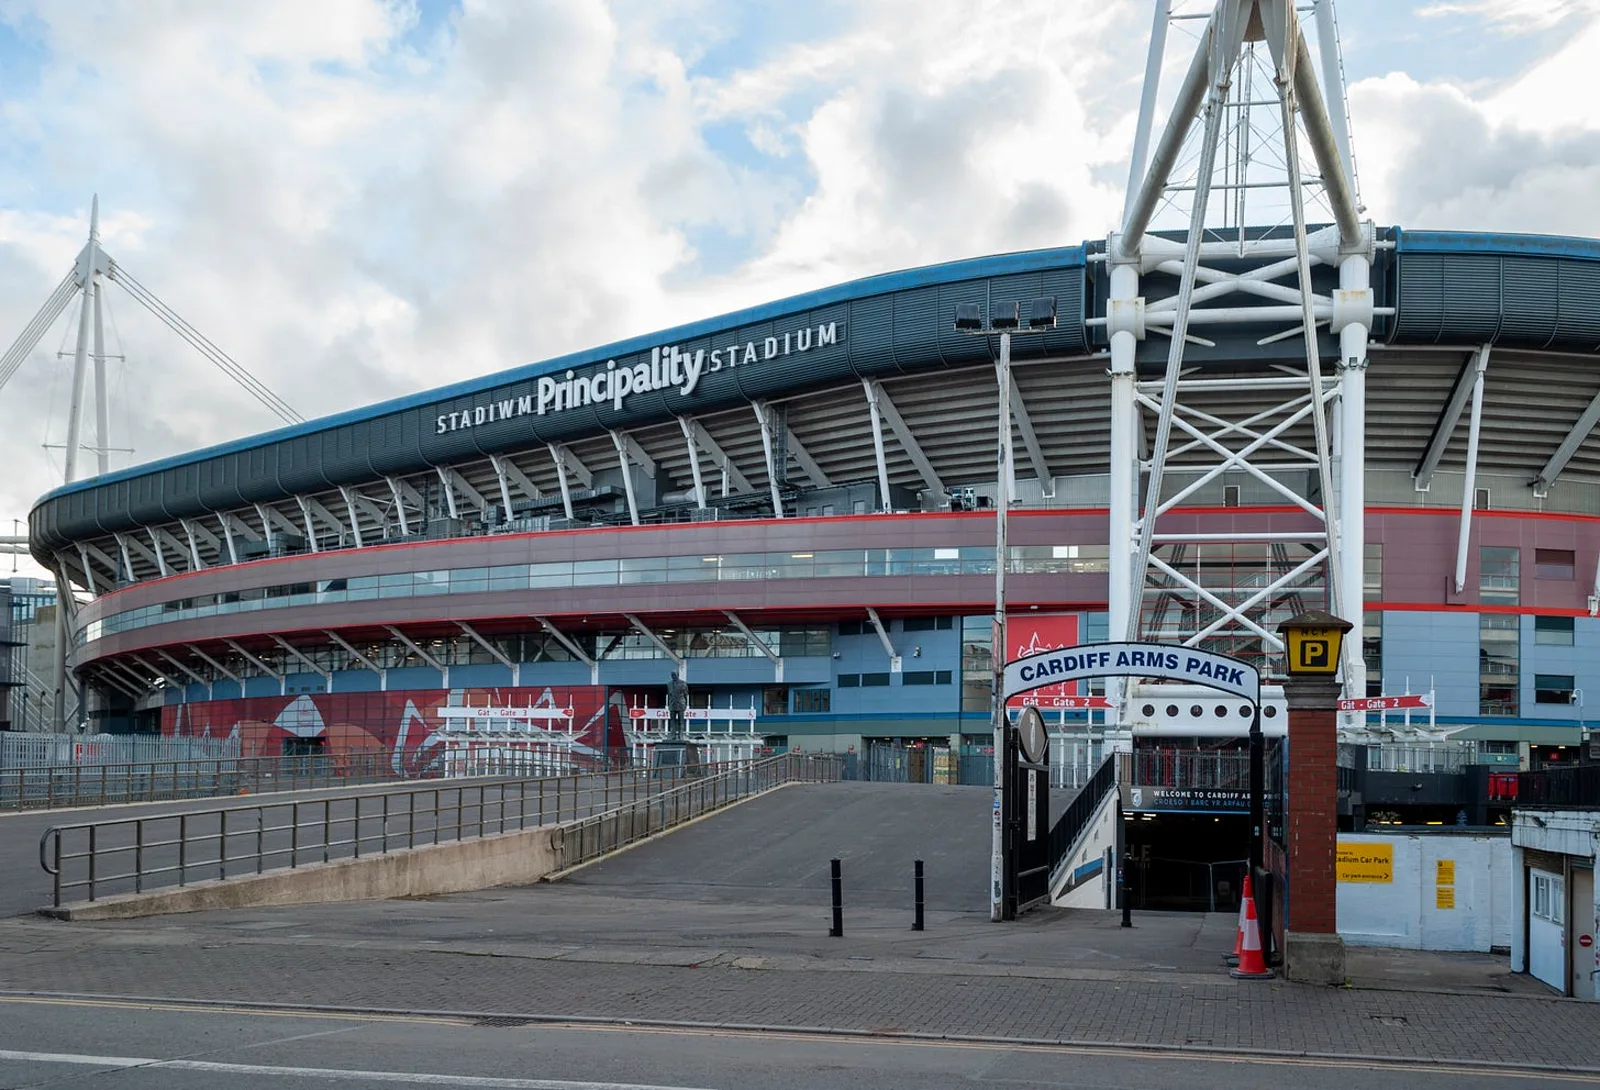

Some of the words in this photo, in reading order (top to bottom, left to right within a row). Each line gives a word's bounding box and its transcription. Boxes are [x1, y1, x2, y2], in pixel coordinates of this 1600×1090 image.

[437, 395, 531, 434] STADIWM
[537, 346, 705, 415] Principality
[710, 322, 836, 372] STADIUM
[1305, 643, 1323, 664] P
[1020, 652, 1110, 681] CARDIFF
[1116, 651, 1179, 670] ARMS
[1186, 657, 1246, 686] PARK
[1053, 698, 1075, 707] Gate
[1084, 698, 1090, 707] 2
[1367, 699, 1386, 709] Gate
[1393, 698, 1399, 707] 2
[1153, 790, 1191, 798] WELCOME
[1194, 791, 1204, 799] TO
[1207, 791, 1239, 800] CARDIFF
[1360, 856, 1372, 864] Car
[1374, 856, 1389, 864] Park
